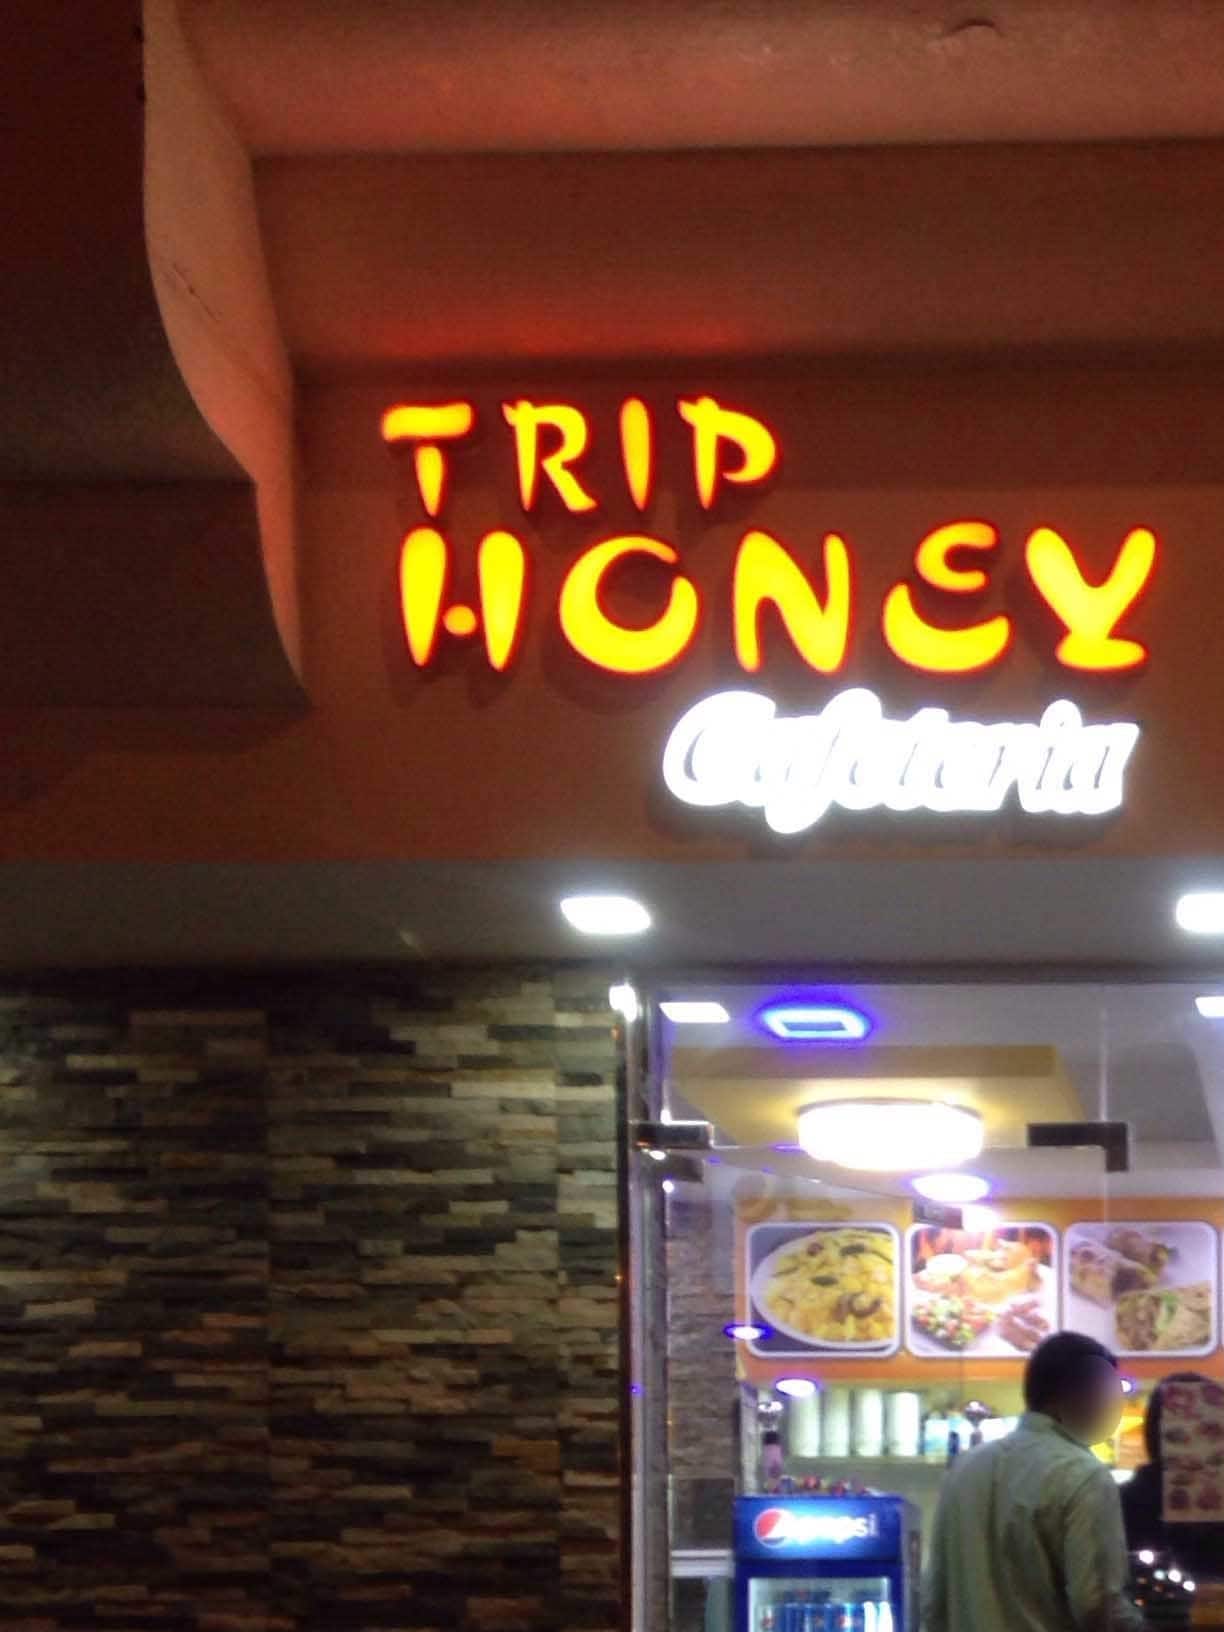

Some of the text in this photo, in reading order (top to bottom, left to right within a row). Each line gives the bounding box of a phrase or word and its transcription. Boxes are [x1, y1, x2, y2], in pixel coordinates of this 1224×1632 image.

[381, 396, 777, 516] TRIP
[399, 521, 1156, 676] HONEY
[662, 687, 1140, 835] Cafeteria
